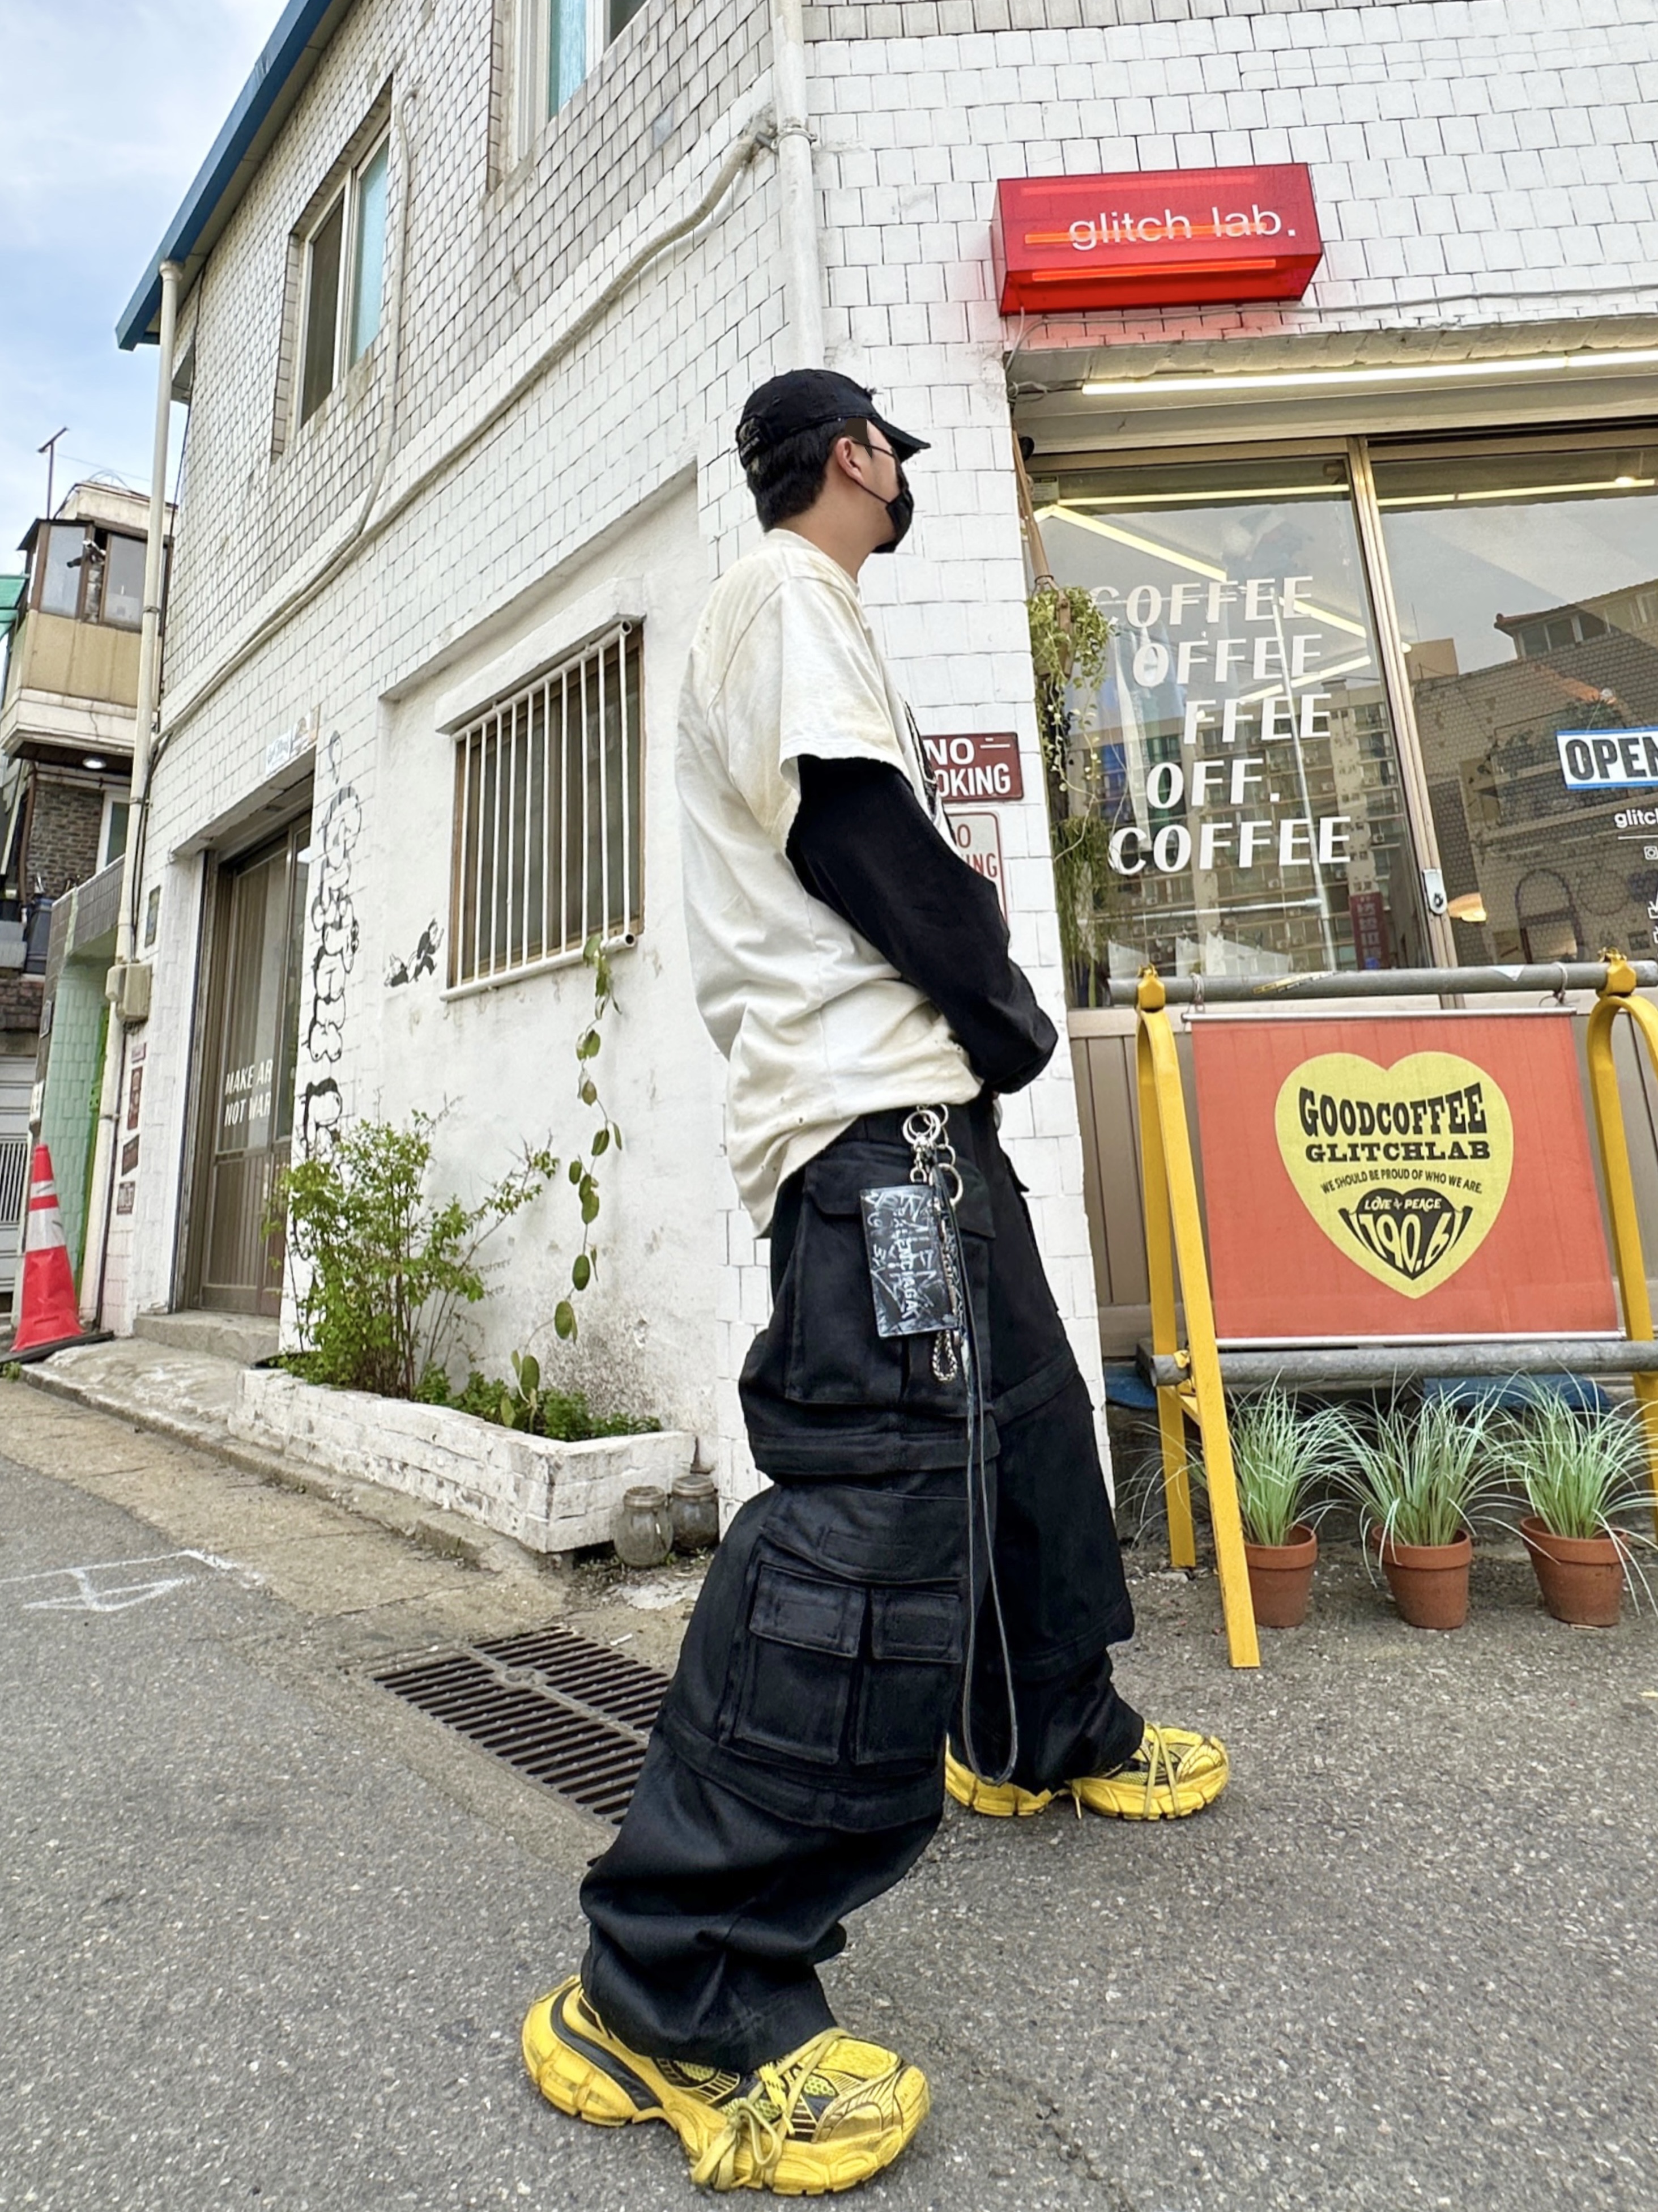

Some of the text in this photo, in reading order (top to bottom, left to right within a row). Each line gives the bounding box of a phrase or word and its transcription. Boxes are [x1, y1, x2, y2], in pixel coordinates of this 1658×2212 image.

[1069, 203, 1297, 250] glitch lab.
[1089, 576, 1313, 628] COFFEE
[1133, 634, 1322, 687] OFFEE
[1183, 693, 1332, 745] FFEE
[922, 738, 975, 765] NO
[935, 763, 1011, 797] OKING
[1145, 758, 1280, 809] OFF.
[1614, 808, 1658, 828] glitc
[1108, 815, 1351, 875] COFFEE
[225, 1058, 273, 1096] MAKE AR
[224, 1091, 271, 1127] NOT WAR
[1298, 1081, 1487, 1138] GOODCOFFEE
[1305, 1141, 1491, 1163] GLITCHLAB
[1320, 1181, 1335, 1194] WE
[1335, 1171, 1368, 1189] SHOULD
[1369, 1169, 1380, 1181] BE
[1380, 1168, 1410, 1180] PROUD
[1412, 1169, 1424, 1180] OF
[1425, 1171, 1447, 1184] WHO
[1448, 1176, 1462, 1188] WE
[1364, 1196, 1392, 1211] LOVE
[1404, 1197, 1443, 1213] PEACE
